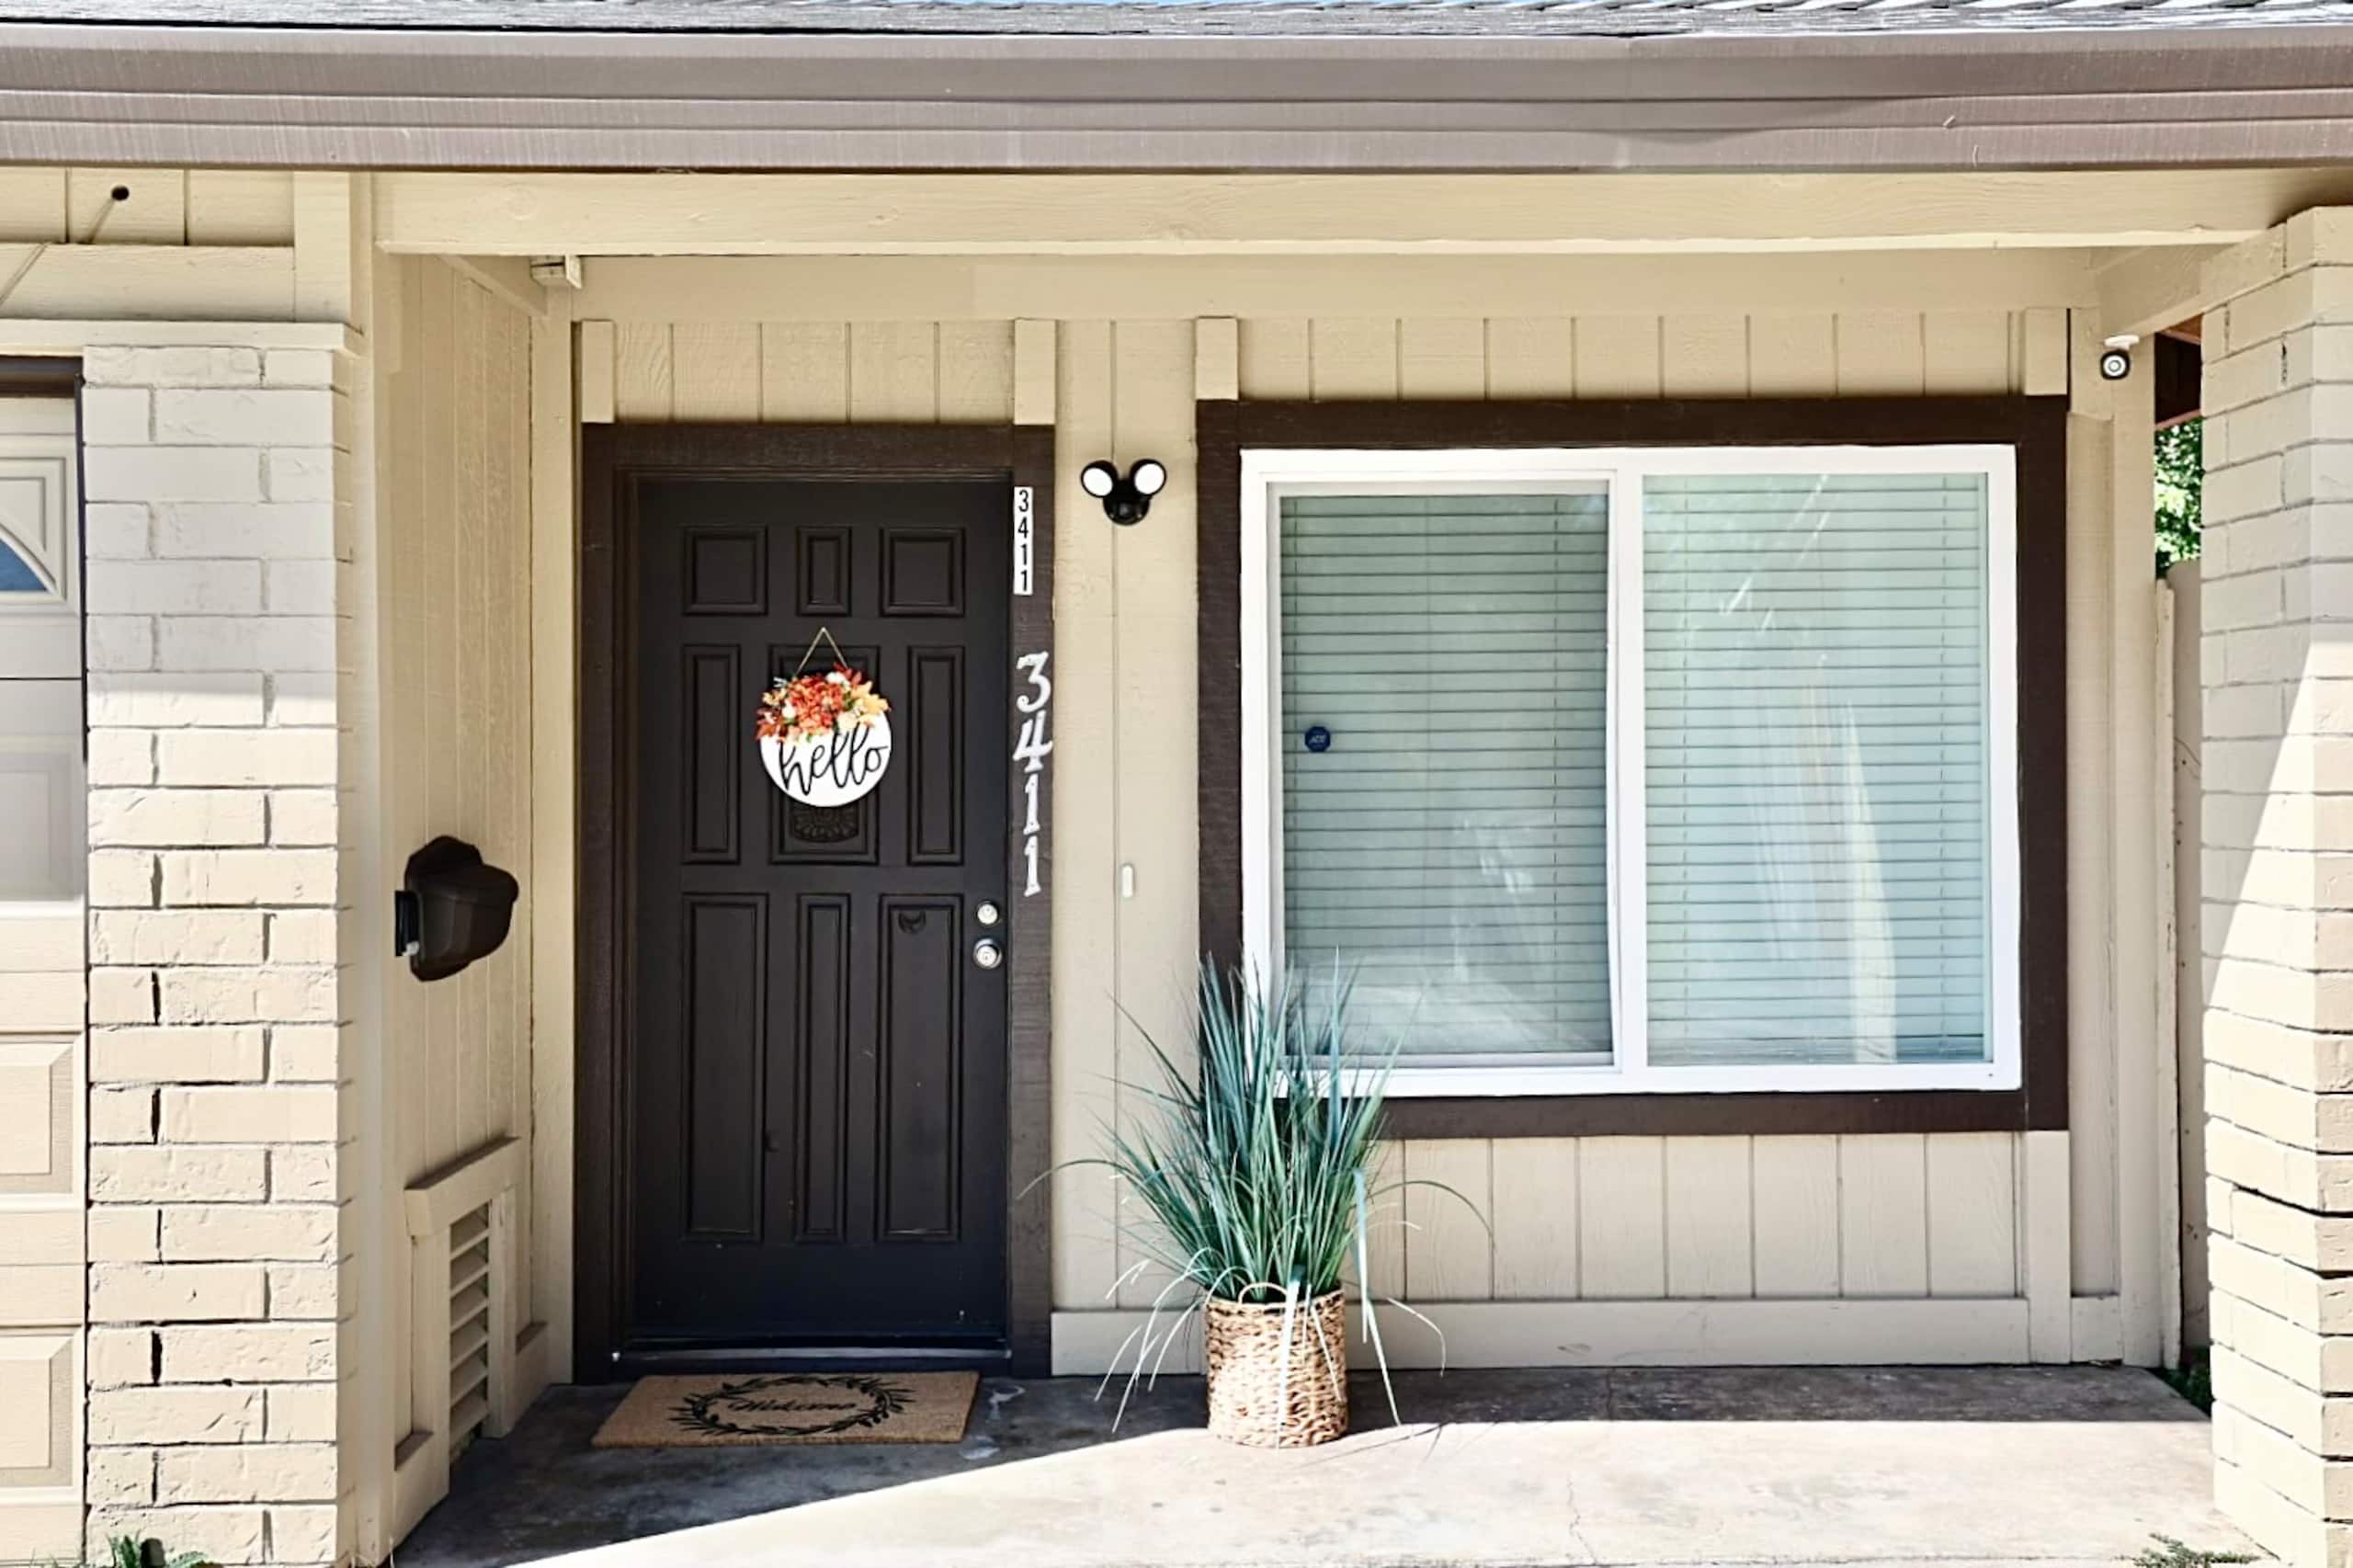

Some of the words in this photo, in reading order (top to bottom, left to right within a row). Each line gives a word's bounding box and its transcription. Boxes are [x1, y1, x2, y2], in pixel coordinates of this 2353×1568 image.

[1017, 489, 1029, 592] 3411
[779, 722, 889, 796] hello
[1013, 651, 1052, 897] 3411
